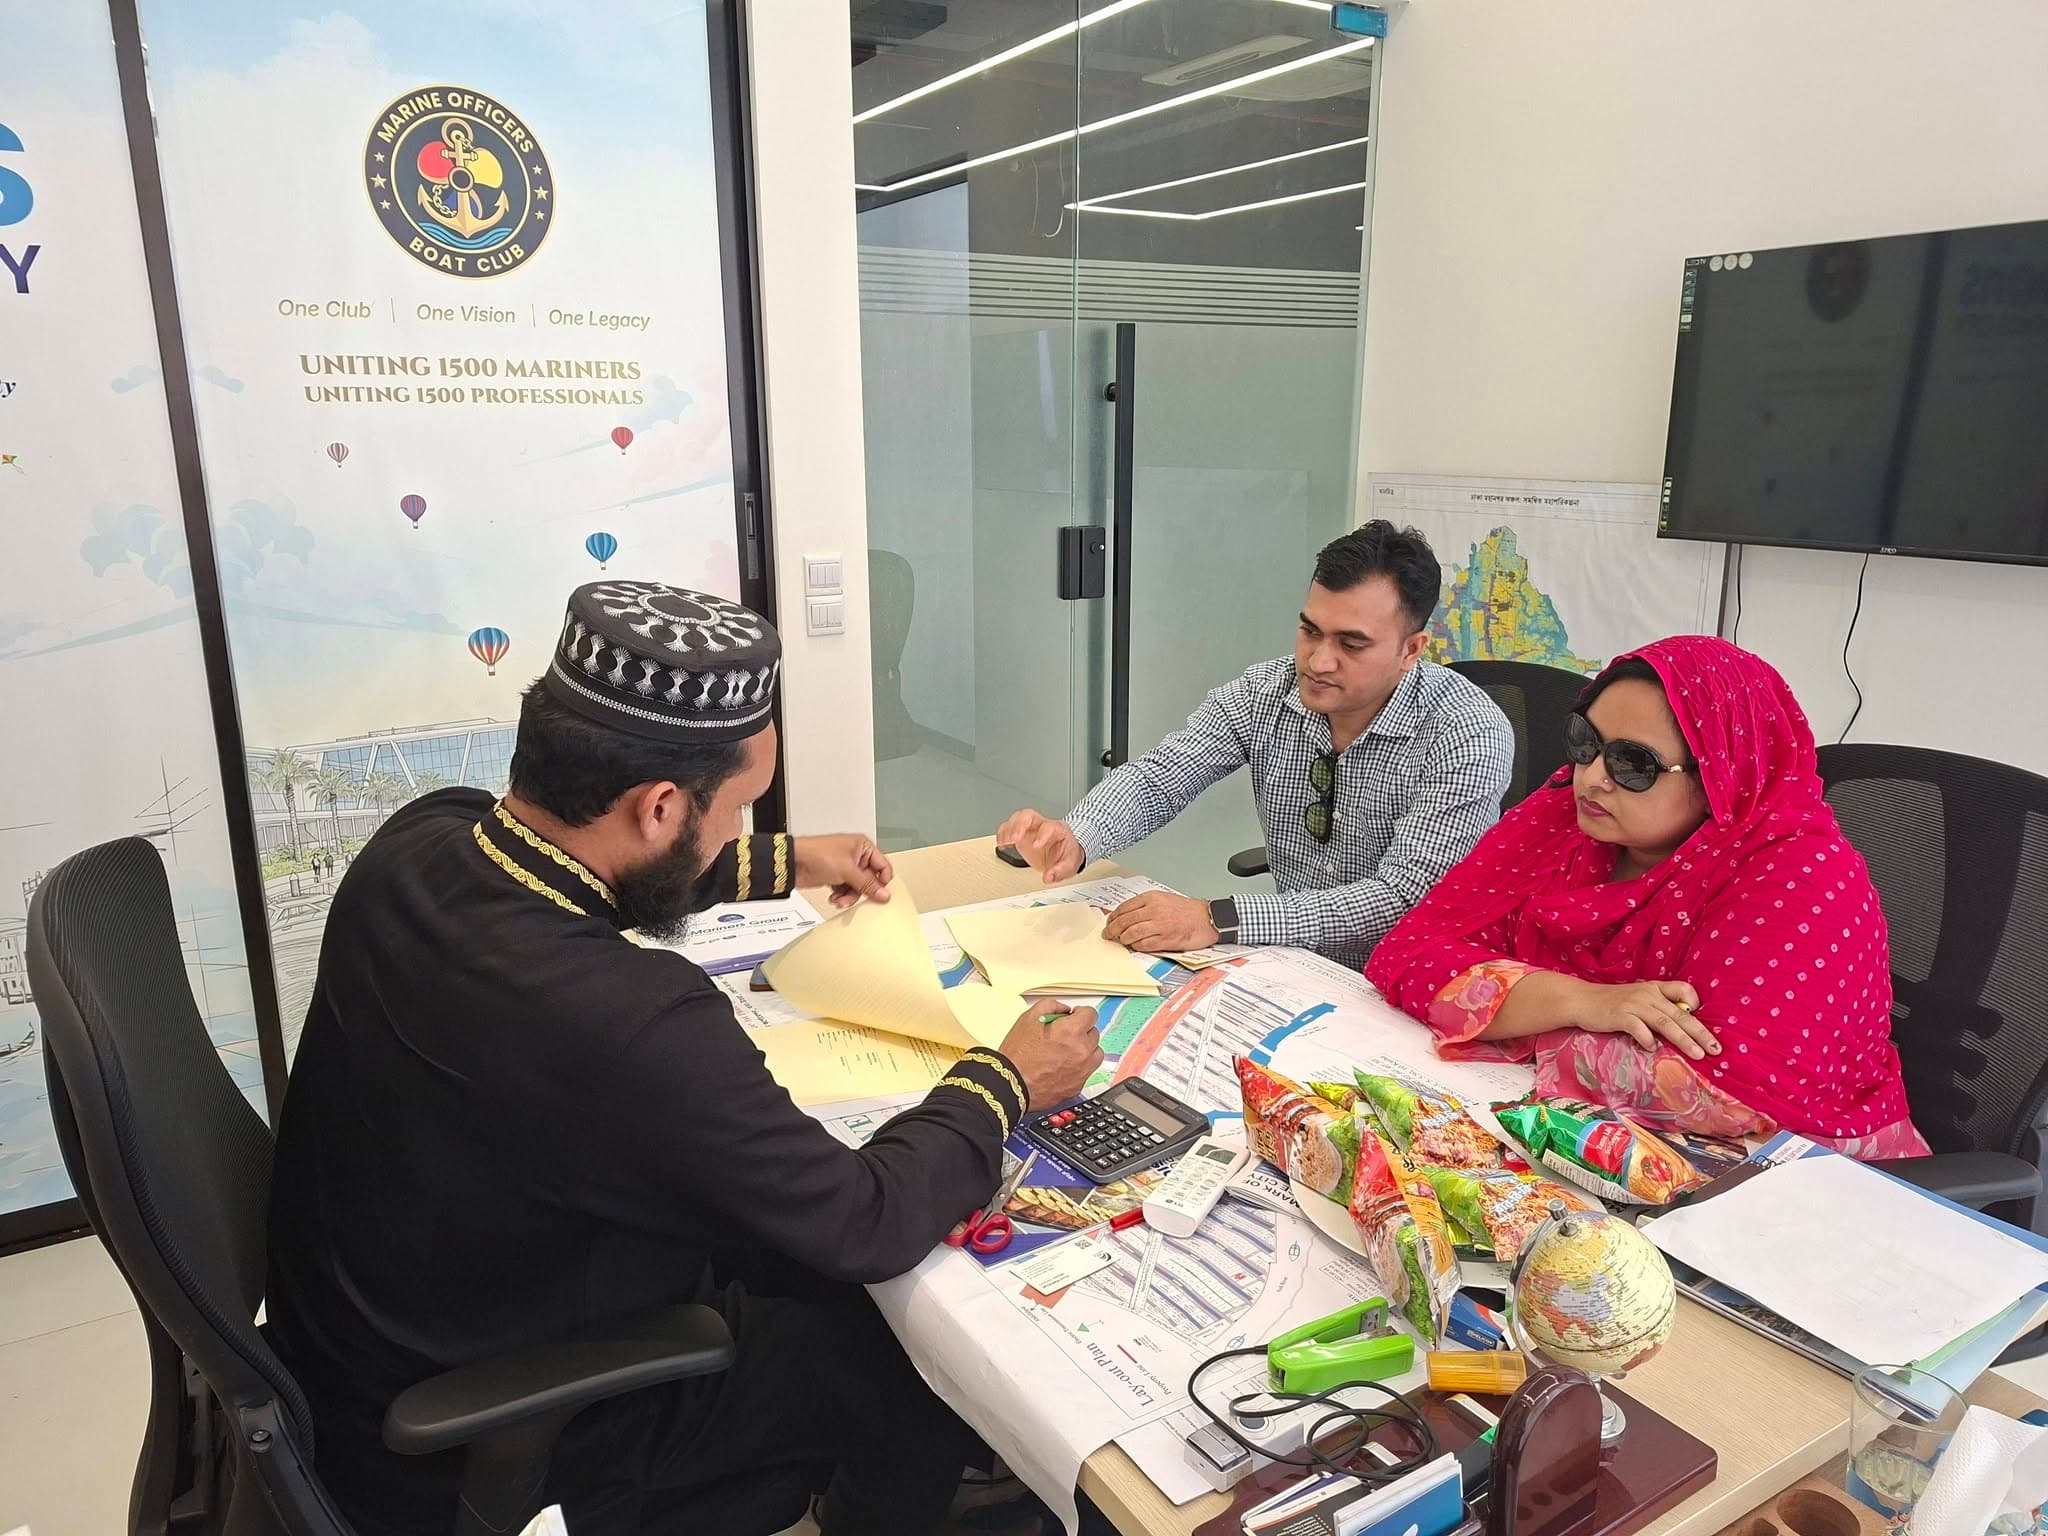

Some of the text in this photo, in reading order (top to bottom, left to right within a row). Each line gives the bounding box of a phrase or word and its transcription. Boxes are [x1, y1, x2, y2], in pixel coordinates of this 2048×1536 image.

[376, 92, 533, 153] MARINE OFFICERS
[409, 236, 525, 272] BOAT CLUB
[278, 299, 372, 319] One Club
[416, 303, 516, 324] One Vision
[549, 309, 650, 332] One Legacy
[300, 354, 641, 380] UNITING 1500 MARINERS
[304, 386, 644, 406] UNITING 1500 PROFESSIONALS
[690, 915, 789, 936] Mariners Group
[1242, 1176, 1260, 1189] OF
[1247, 1169, 1279, 1189] CITY
[1086, 1341, 1113, 1368] Plan
[1108, 1364, 1155, 1406] Lay-out
[1137, 1364, 1172, 1395] Property Line
